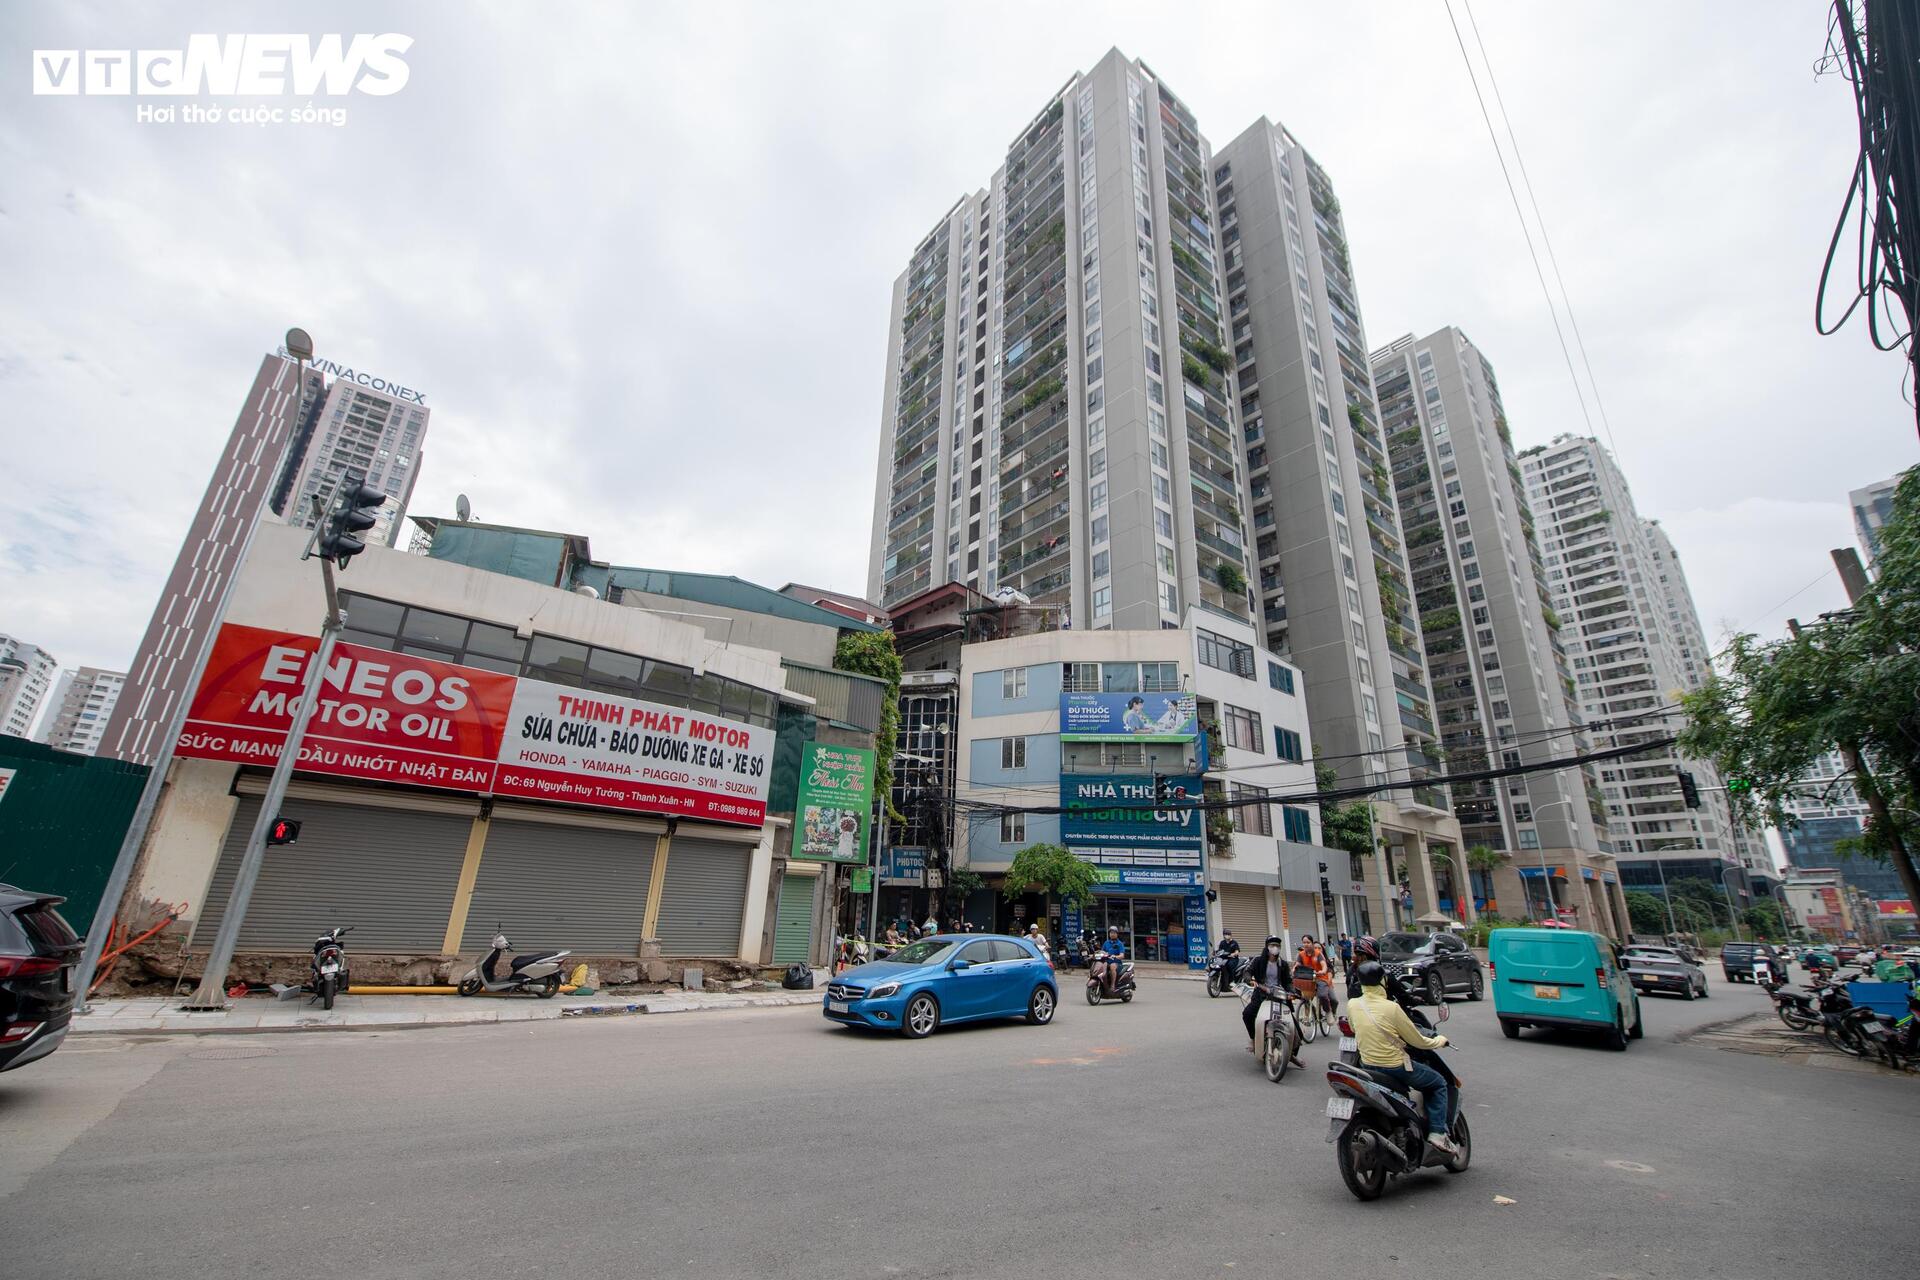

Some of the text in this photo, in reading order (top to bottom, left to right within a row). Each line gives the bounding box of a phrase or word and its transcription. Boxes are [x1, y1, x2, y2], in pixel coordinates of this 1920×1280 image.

[310, 358, 426, 406] VINACONEX
[260, 645, 470, 711] ENEOS
[248, 690, 454, 742] MOTOR OIL
[558, 695, 750, 750] THỊNH PHÁT MOTOR
[1068, 705, 1110, 714] ĐỦ THUỐC
[177, 732, 226, 751] SỨC
[297, 744, 339, 765] DẦU
[341, 752, 398, 775] NHỚT
[399, 759, 449, 780] NHẬT
[452, 765, 488, 784] BẢN
[521, 711, 553, 742] SỬA
[558, 717, 597, 749] CHỮA
[609, 727, 640, 753] BẢO
[642, 736, 688, 765] DƯỠNG
[690, 743, 708, 766] XE
[709, 750, 724, 770] GA
[733, 753, 748, 774] XE
[749, 754, 764, 777] SỐ
[519, 749, 567, 767] HONDA
[581, 758, 632, 776] YAMAHA
[642, 768, 689, 783] PIAGGIO
[697, 776, 718, 789] SYM
[725, 781, 758, 795] SUZUKI
[537, 779, 573, 794] Nguyễn
[574, 785, 593, 797] Huy
[595, 786, 625, 801] Tưởng
[631, 791, 657, 803] Thanh
[658, 795, 679, 806] Xuân
[683, 798, 695, 808] HN
[1078, 782, 1118, 798] NHÀ
[1189, 952, 1208, 964] TỐT
